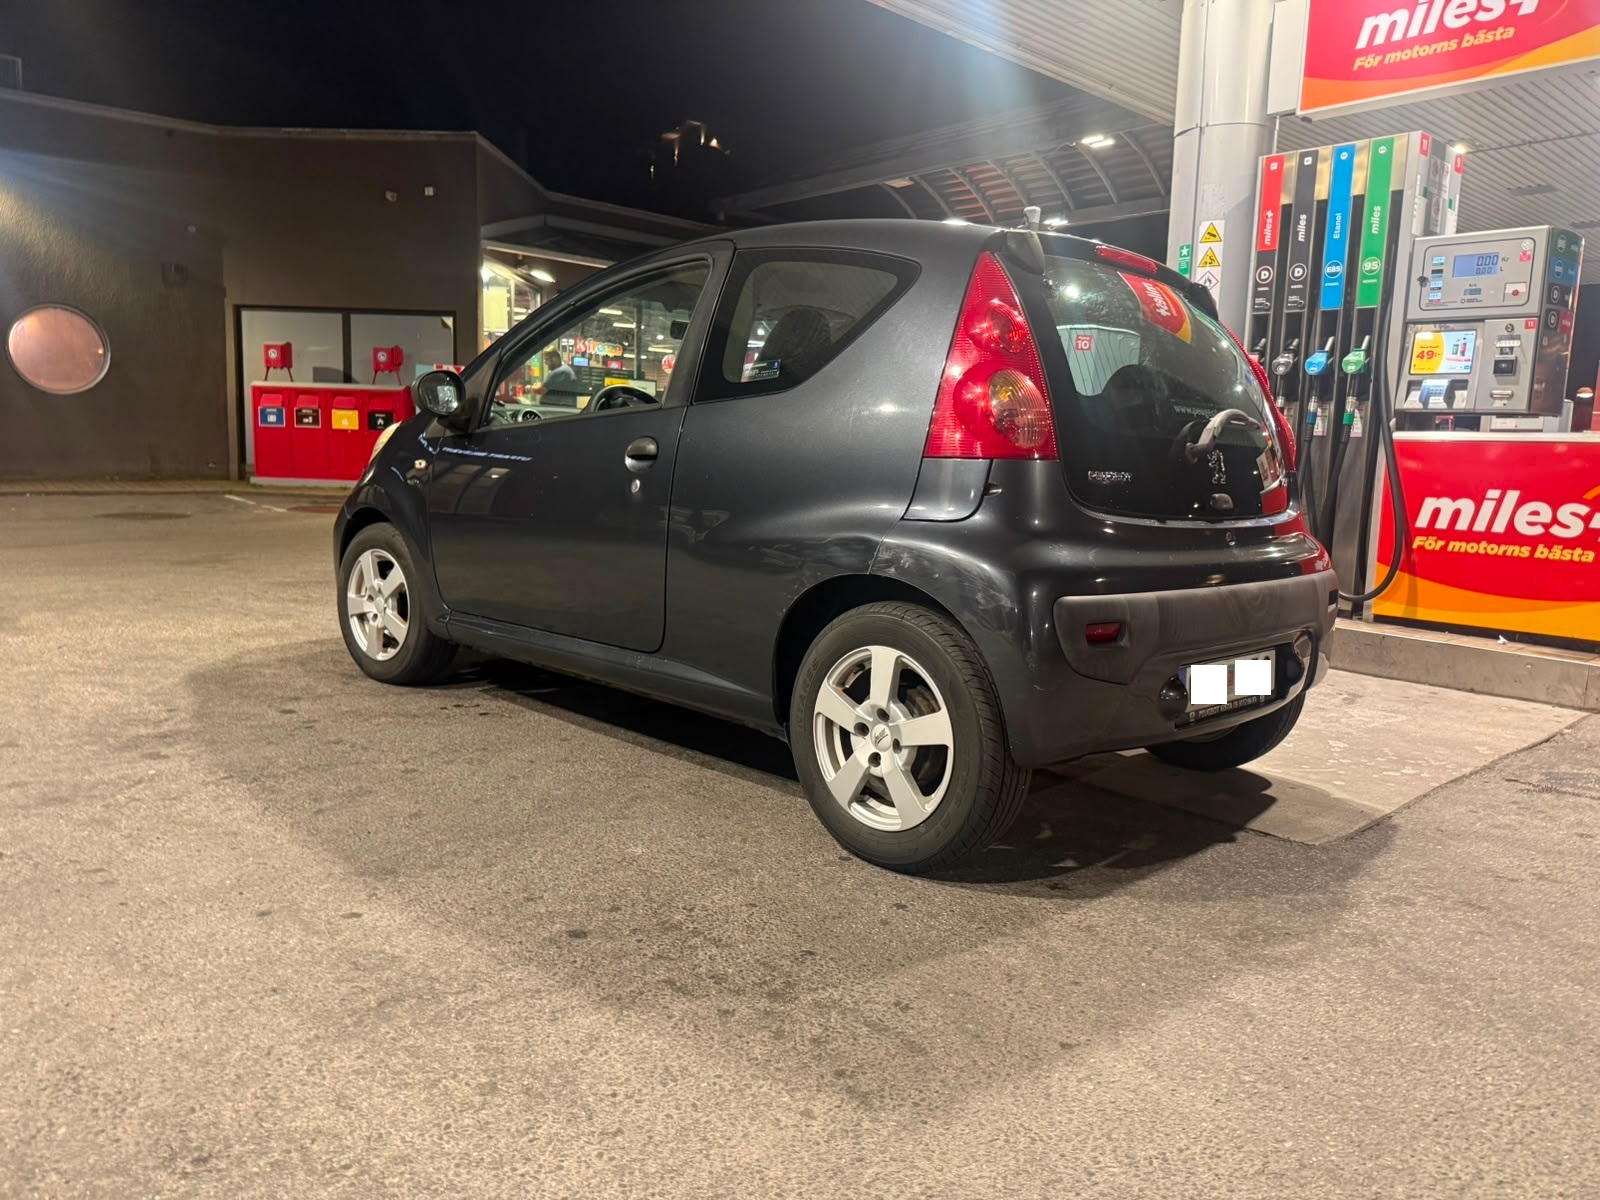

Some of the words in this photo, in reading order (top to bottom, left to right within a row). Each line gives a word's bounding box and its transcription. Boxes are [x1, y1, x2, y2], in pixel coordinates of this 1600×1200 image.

[1352, 54, 1383, 71] För
[1384, 38, 1458, 65] motorns
[1461, 26, 1515, 48] bästa
[1297, 214, 1307, 242] miles
[1332, 212, 1342, 240] Etanol
[1370, 205, 1381, 235] miles
[1363, 261, 1379, 271] 95
[1412, 536, 1446, 551] För
[1447, 540, 1531, 558] motorns
[1534, 544, 1595, 563] bästa
